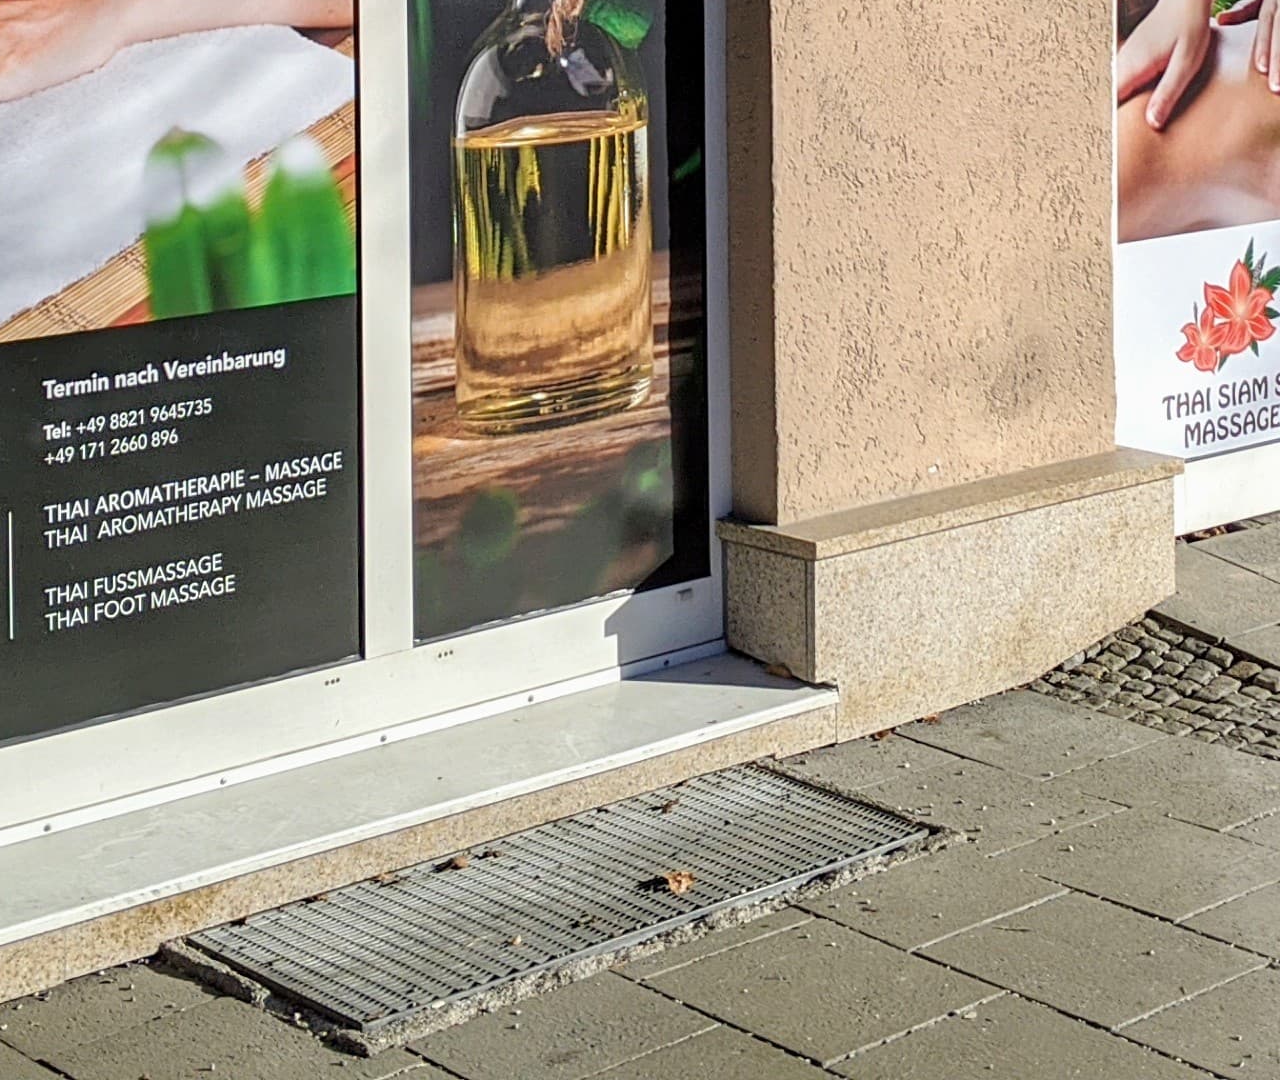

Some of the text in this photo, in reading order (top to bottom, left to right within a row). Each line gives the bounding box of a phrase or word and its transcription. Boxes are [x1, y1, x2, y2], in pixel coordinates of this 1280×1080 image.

[42, 348, 286, 400] Termin nach Vereinbarung
[1161, 387, 1212, 421] THAI
[1218, 375, 1269, 409] SIAM
[42, 397, 213, 441] Tel: +49 8821 9645735
[1184, 403, 1280, 449] MASSAGE
[43, 428, 179, 465] +49 171 2660 896
[43, 498, 90, 524] THAI
[94, 469, 246, 515] AROMATHERAPIE
[265, 451, 343, 482] MASSAGE
[43, 477, 327, 549] THAI AROMATHERAPY MASSAGE
[44, 552, 223, 606] THAI FUSSMASSAGE
[44, 574, 236, 632] THAI FOOT MASSAGE
